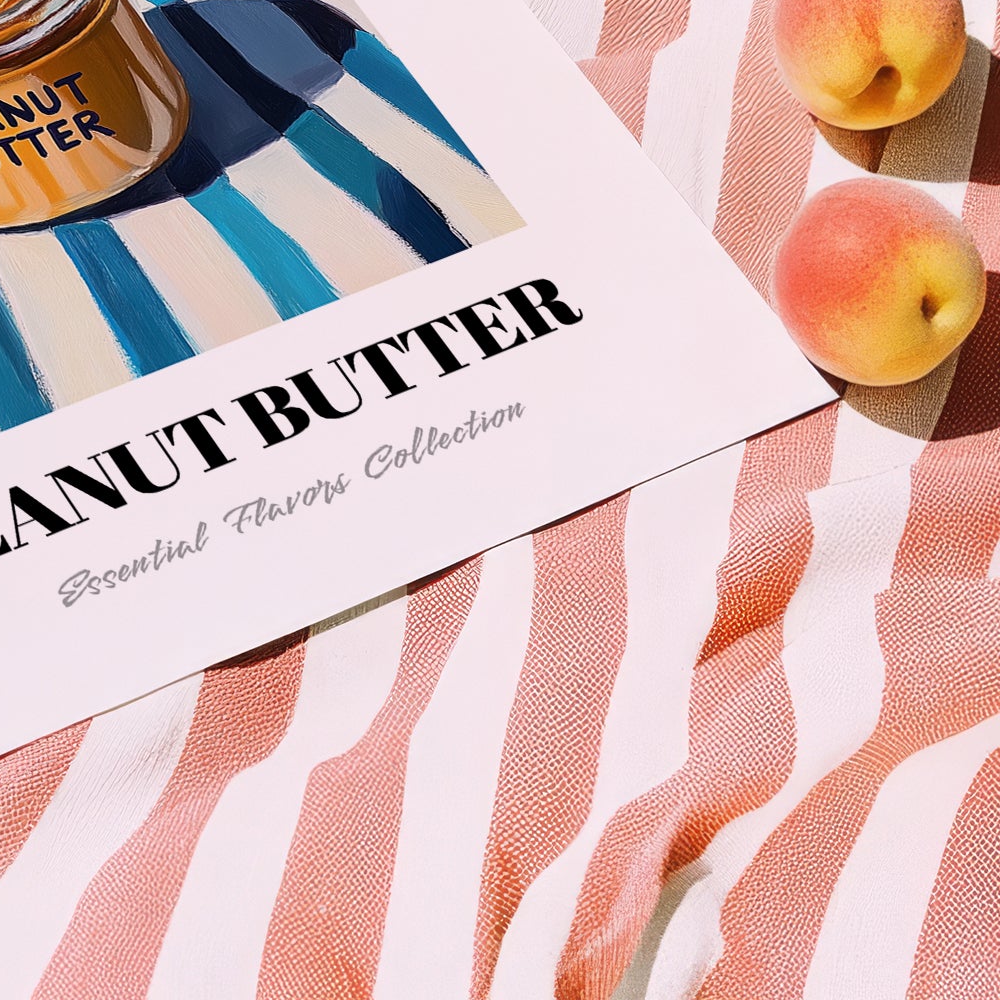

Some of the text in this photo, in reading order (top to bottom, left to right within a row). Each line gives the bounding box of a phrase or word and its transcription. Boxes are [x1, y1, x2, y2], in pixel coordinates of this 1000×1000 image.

[230, 278, 583, 449] BUTTER
[57, 402, 526, 607] Essential Flavors Collection
